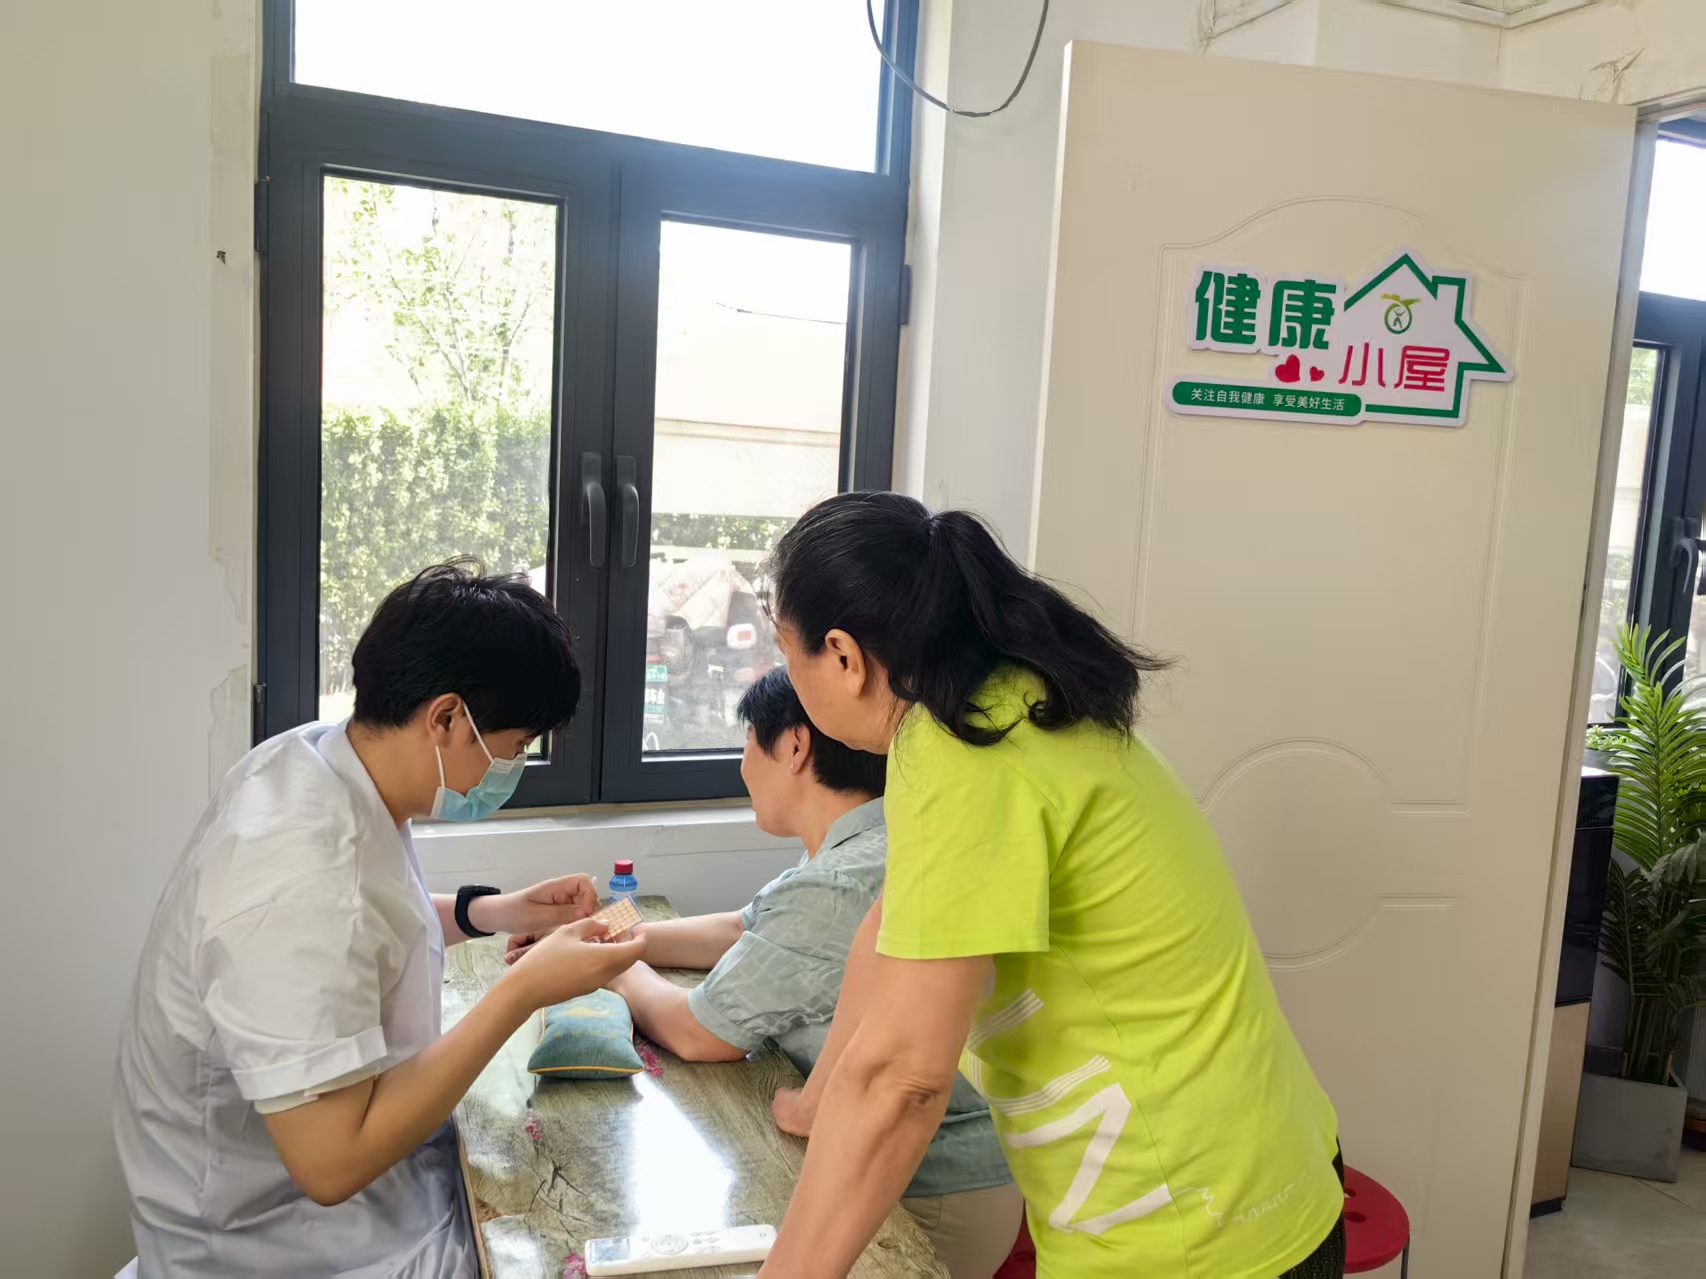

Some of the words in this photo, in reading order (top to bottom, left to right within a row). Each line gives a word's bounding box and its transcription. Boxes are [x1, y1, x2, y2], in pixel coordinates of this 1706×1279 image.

[1195, 270, 1337, 350] 健康
[1338, 342, 1450, 392] 小屋
[1191, 387, 1265, 405] 关注自我健康
[1272, 393, 1345, 411] 享受美好生活
